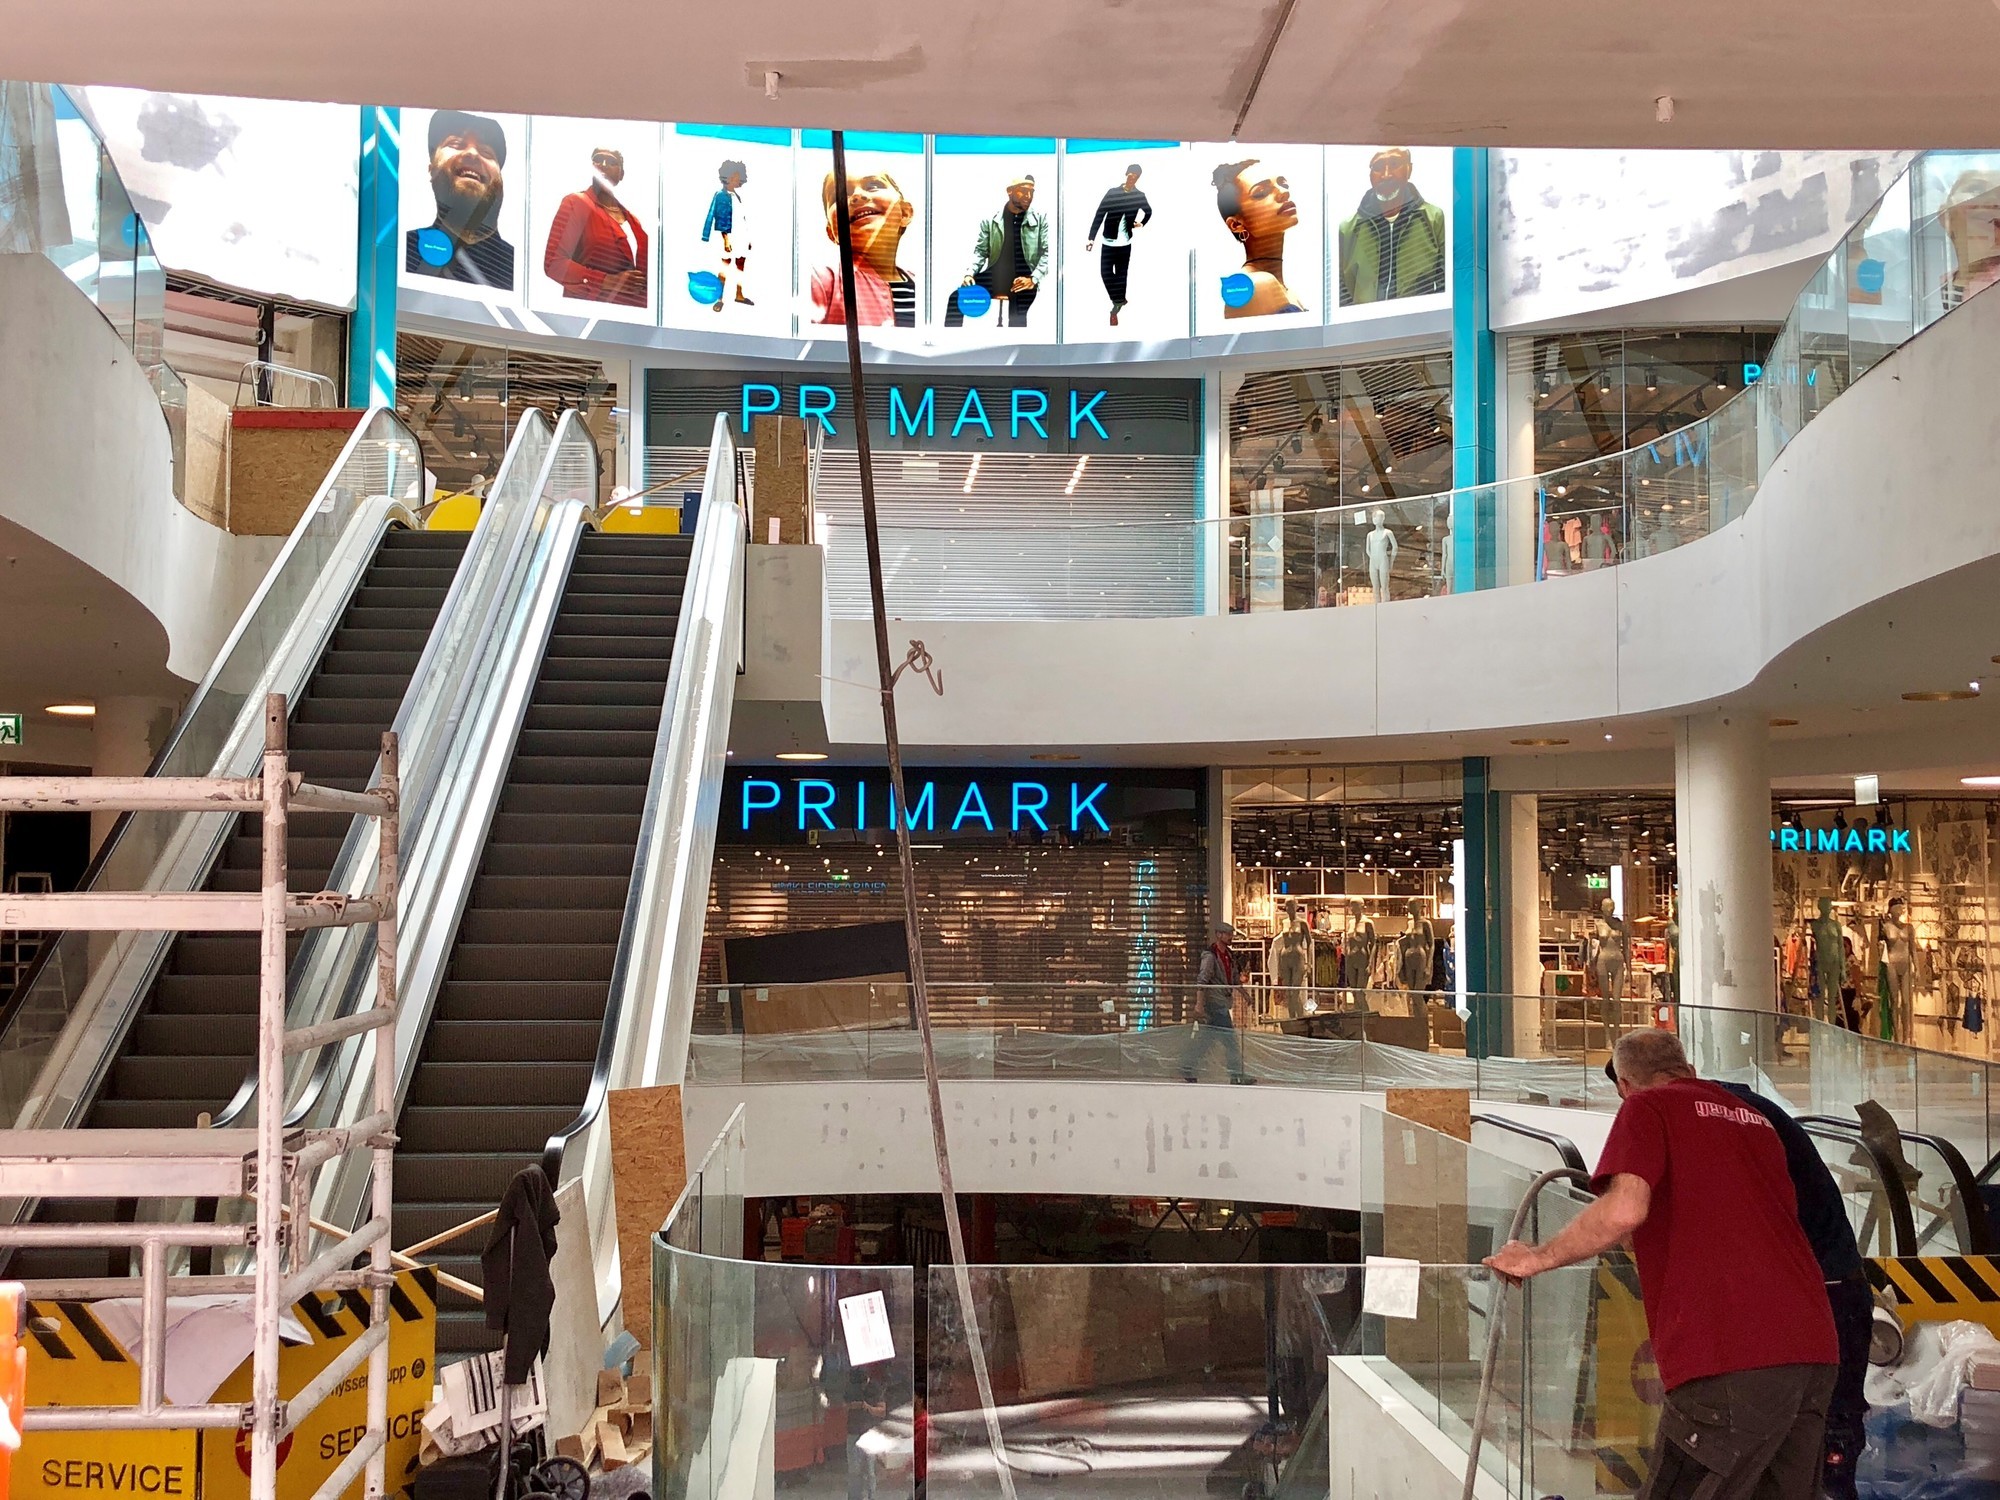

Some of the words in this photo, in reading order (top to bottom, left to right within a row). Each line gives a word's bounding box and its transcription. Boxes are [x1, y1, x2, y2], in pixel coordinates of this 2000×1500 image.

[742, 383, 1109, 440] PRMARK
[742, 780, 1110, 832] PRIMARK
[319, 1408, 425, 1460] SERICE
[42, 1458, 184, 1495] SERVICE
